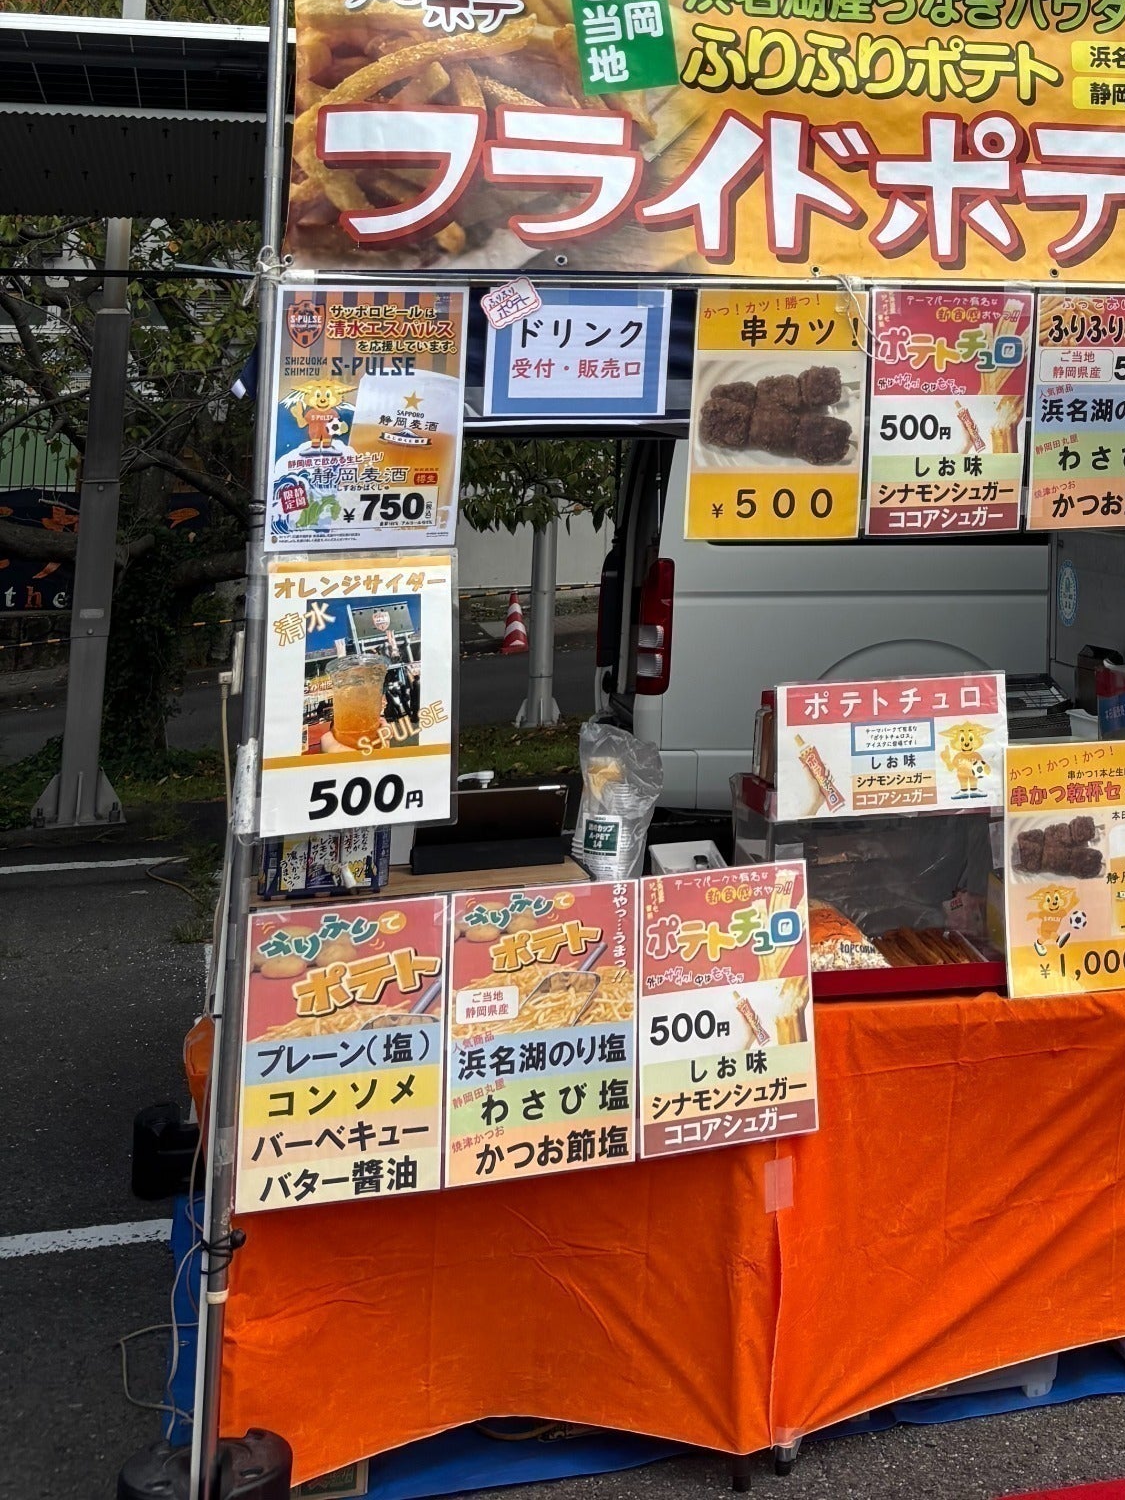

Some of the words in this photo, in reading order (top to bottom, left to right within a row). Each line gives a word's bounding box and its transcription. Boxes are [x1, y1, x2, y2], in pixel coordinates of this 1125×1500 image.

[680, 24, 1063, 103] ふりふりポテト
[330, 305, 437, 321] サッポロビールは
[907, 295, 999, 307] テーマパークで有名な
[327, 320, 455, 339] 清水エスパルス
[520, 319, 644, 350] ドリンク
[285, 356, 328, 366] SHIZUOKA
[357, 340, 459, 355] を応援しています。
[878, 325, 1025, 373] ポテトチュロ
[1060, 351, 1096, 363] ご当地
[285, 367, 321, 377] SHIMIZU
[331, 356, 417, 377] S-PULSE
[511, 357, 642, 380] 受付・販売口
[1052, 365, 1102, 379] 静岡県産
[378, 414, 440, 433] 静岡麦酒
[396, 409, 425, 419] SAPPORO
[879, 414, 951, 441] 500円
[311, 466, 411, 486] 静岡麦酒
[915, 456, 983, 478] しお味
[711, 488, 834, 520] ¥500
[878, 481, 1015, 505] シナモンシュガー
[342, 492, 426, 524] ¥750
[888, 506, 1004, 529] ココアシュガー
[273, 571, 447, 599] オレンジサイダー
[273, 601, 337, 647] 清水
[803, 685, 982, 720] ポテトチュロ
[356, 699, 449, 756] S-PULSE
[870, 754, 917, 770] しお味
[856, 773, 933, 789] シナモンシュガー
[308, 773, 424, 821] 500円
[855, 789, 935, 807] ココアシュガー
[490, 919, 603, 973] ポテト
[645, 907, 802, 962] ポテトチュロ
[295, 947, 442, 1017] ポテト
[471, 990, 504, 1003] ご当地
[465, 1003, 509, 1019] 静岡県産
[452, 1029, 496, 1053] 人気商品
[649, 1009, 731, 1046] 500円
[256, 1029, 430, 1078] プレーン(塩)
[458, 1032, 628, 1081] 浜名湖のり塩
[690, 1050, 768, 1083] しお味
[267, 1074, 416, 1117] コンソメ
[481, 1077, 630, 1126] わさび塩
[652, 1076, 808, 1121] シナモンシュガー
[664, 1107, 799, 1146] ココアシュガー
[251, 1120, 430, 1162] バーベキュー
[475, 1124, 630, 1176] かつお節塩
